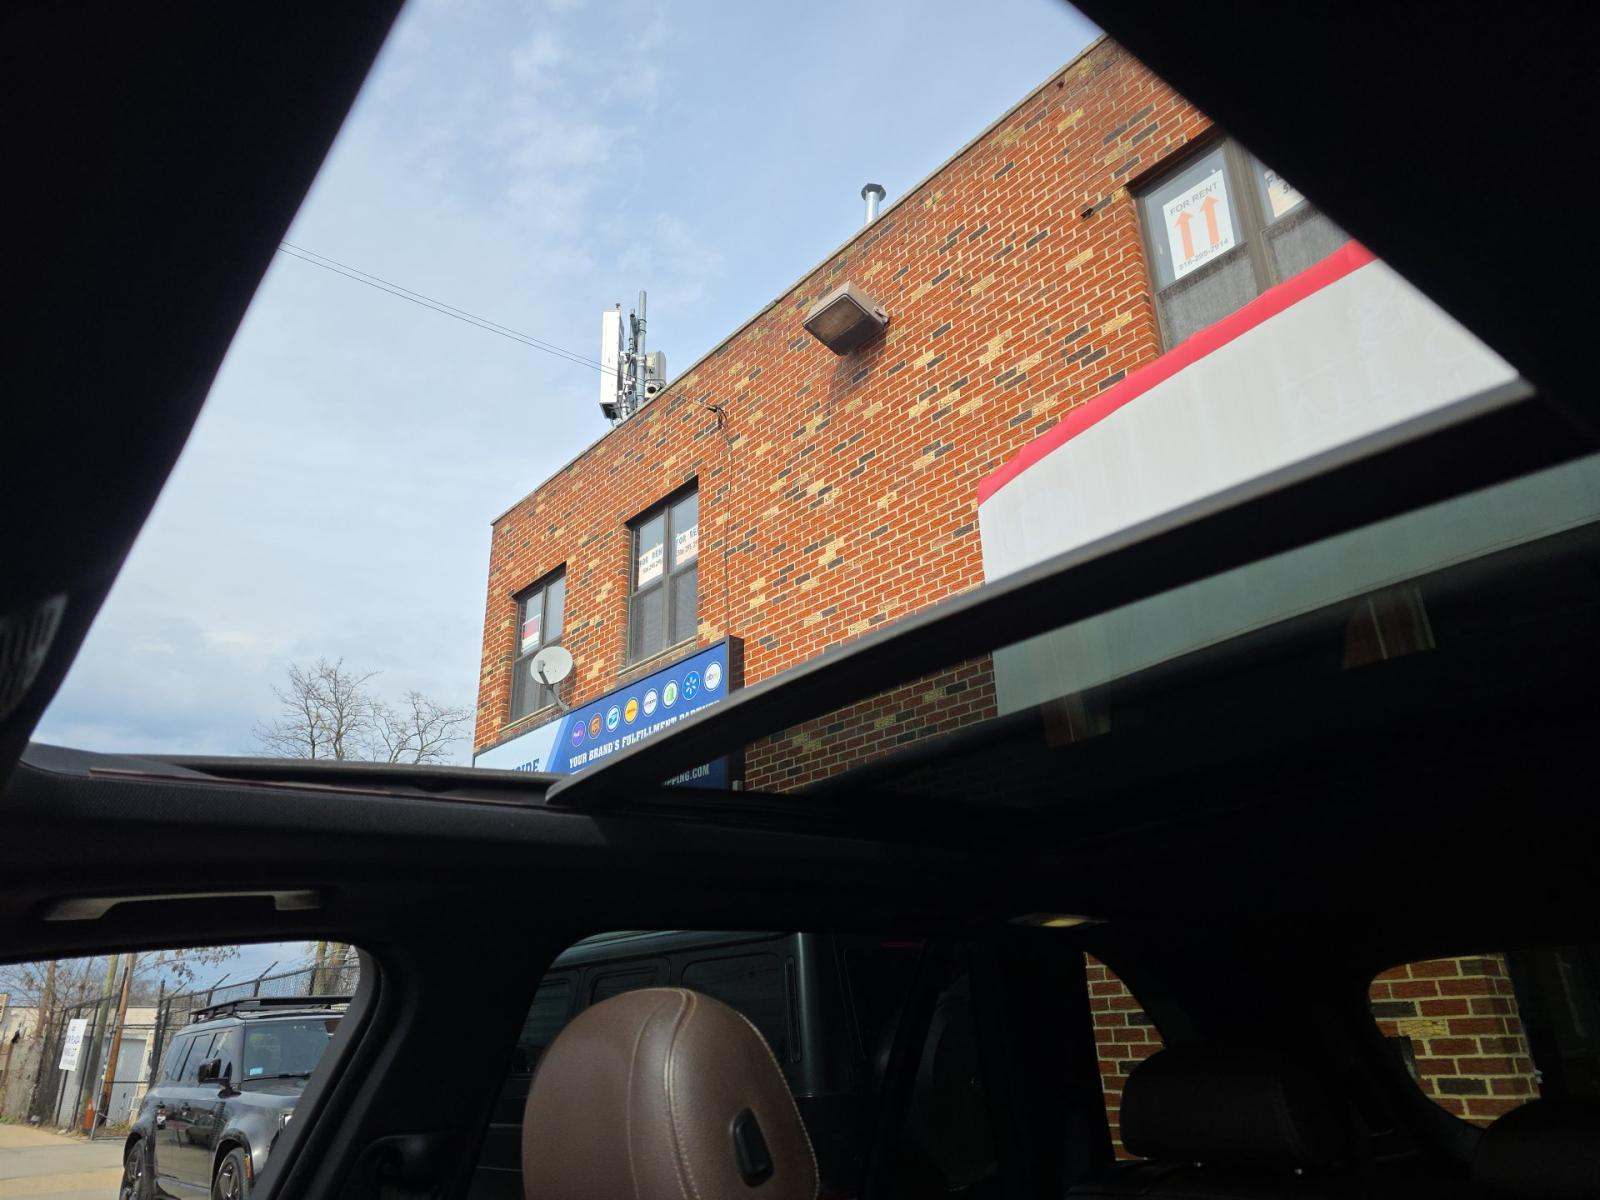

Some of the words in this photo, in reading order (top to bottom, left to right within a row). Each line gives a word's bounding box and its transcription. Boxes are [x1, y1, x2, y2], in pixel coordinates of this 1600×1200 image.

[1169, 199, 1190, 216] FOR
[1192, 182, 1218, 202] RENT
[570, 752, 587, 769] YOUR
[589, 739, 620, 761] BRAND'S
